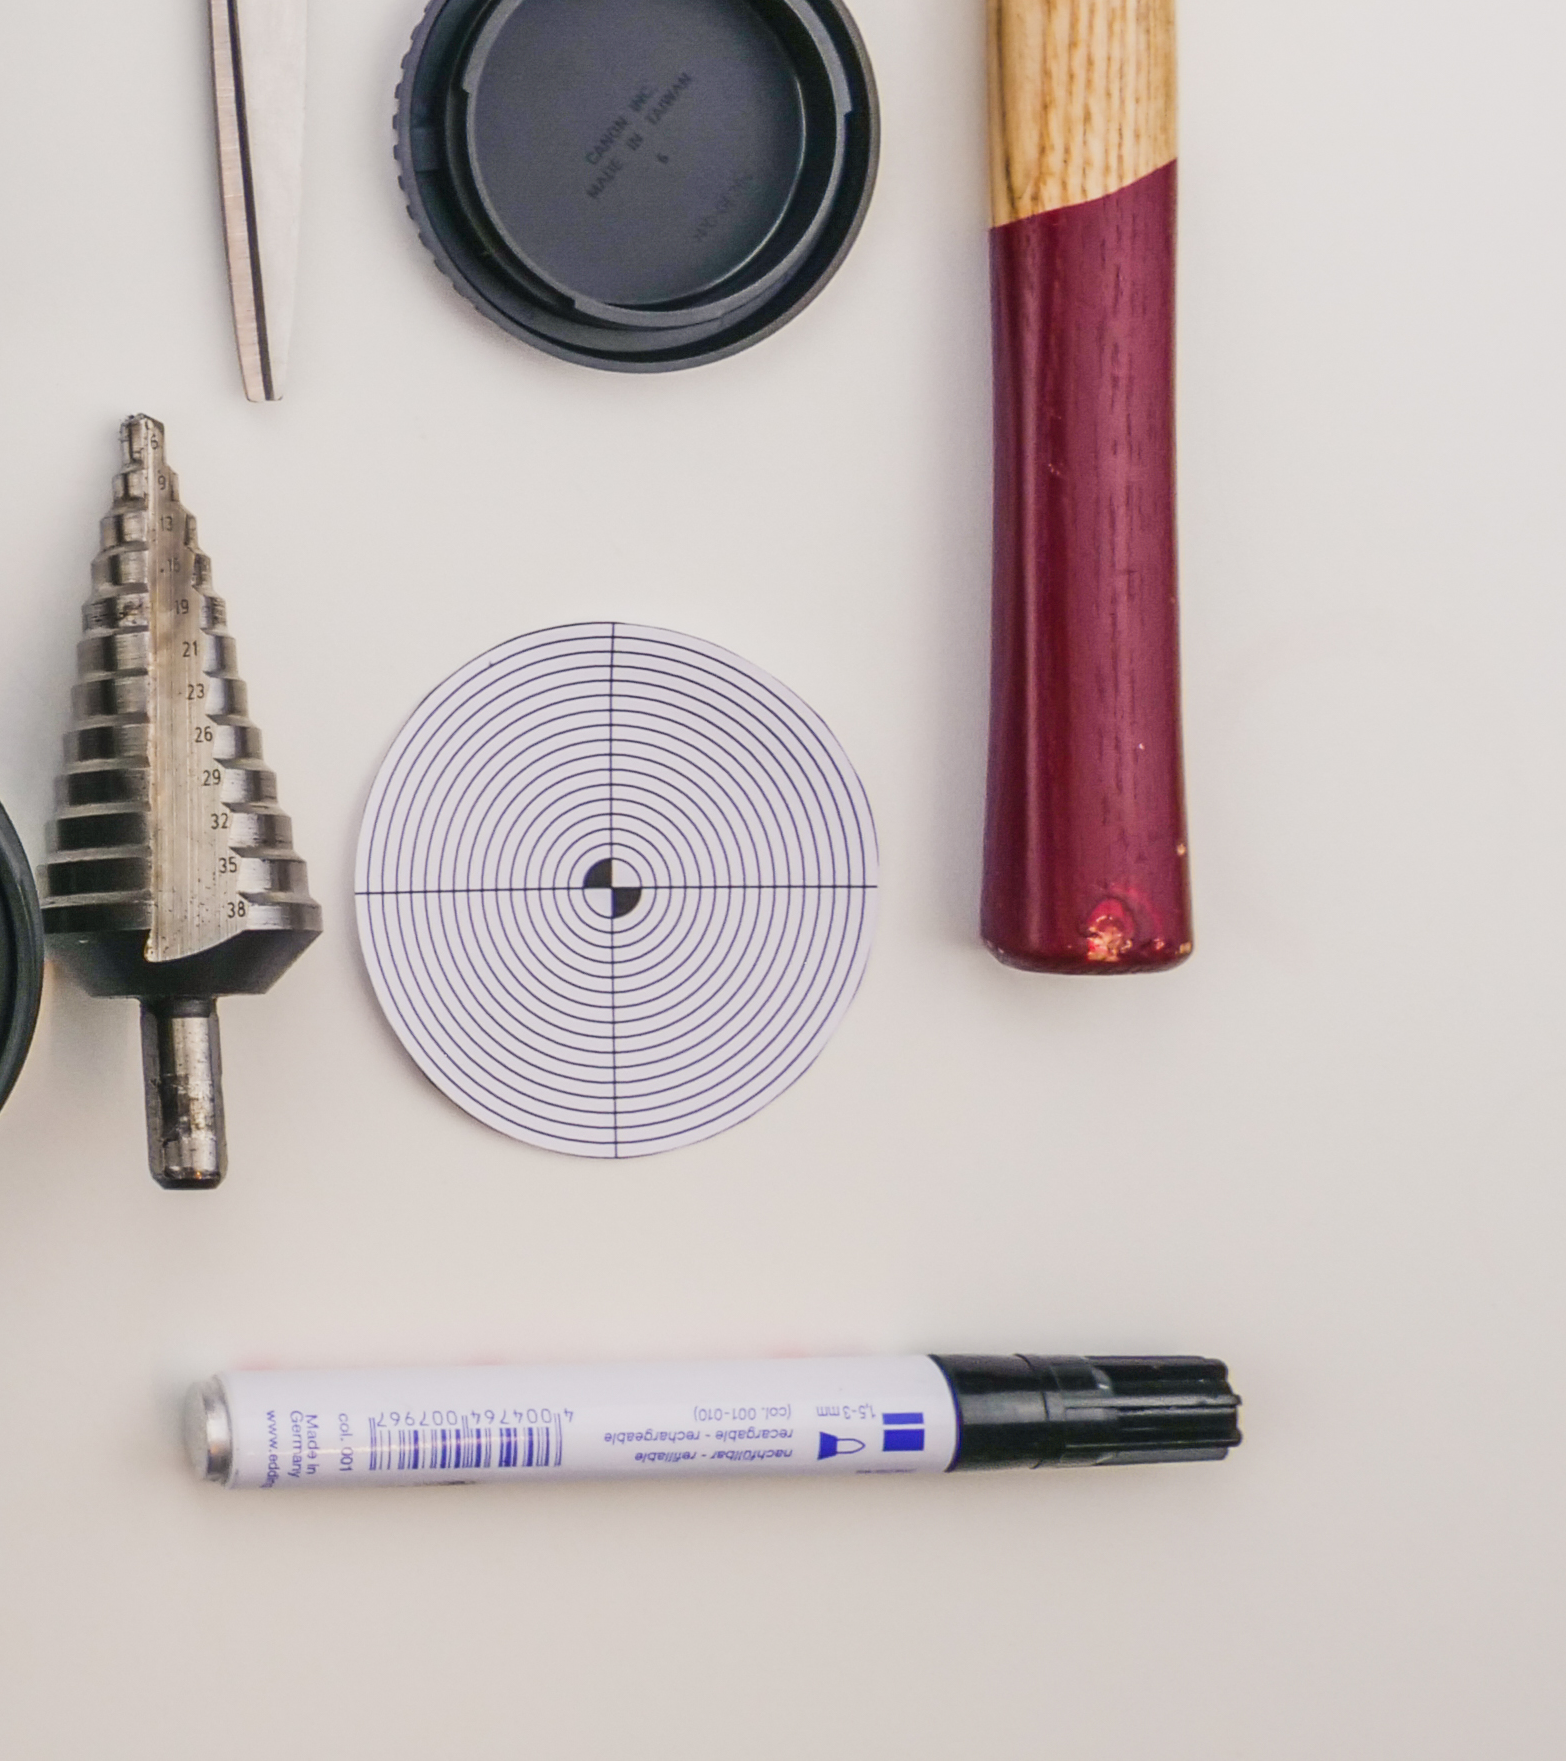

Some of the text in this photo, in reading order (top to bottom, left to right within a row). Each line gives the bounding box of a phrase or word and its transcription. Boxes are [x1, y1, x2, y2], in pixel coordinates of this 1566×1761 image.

[585, 115, 628, 165] CANON
[174, 598, 189, 615] 19
[182, 641, 199, 658] 21
[186, 683, 205, 700] 23
[194, 726, 213, 743] 26
[202, 768, 221, 786] 29
[210, 812, 229, 830] 32
[218, 856, 238, 874] 35
[226, 900, 247, 918] 38
[376, 1410, 459, 1427] 007967
[693, 1404, 792, 1422] (col. 001-010)
[287, 1410, 304, 1478] Germany
[304, 1414, 321, 1459] Made
[338, 1413, 354, 1472] col. 001
[603, 1428, 794, 1443] recargable rechargeable
[634, 1448, 793, 1461] nachfüllbar refillable
